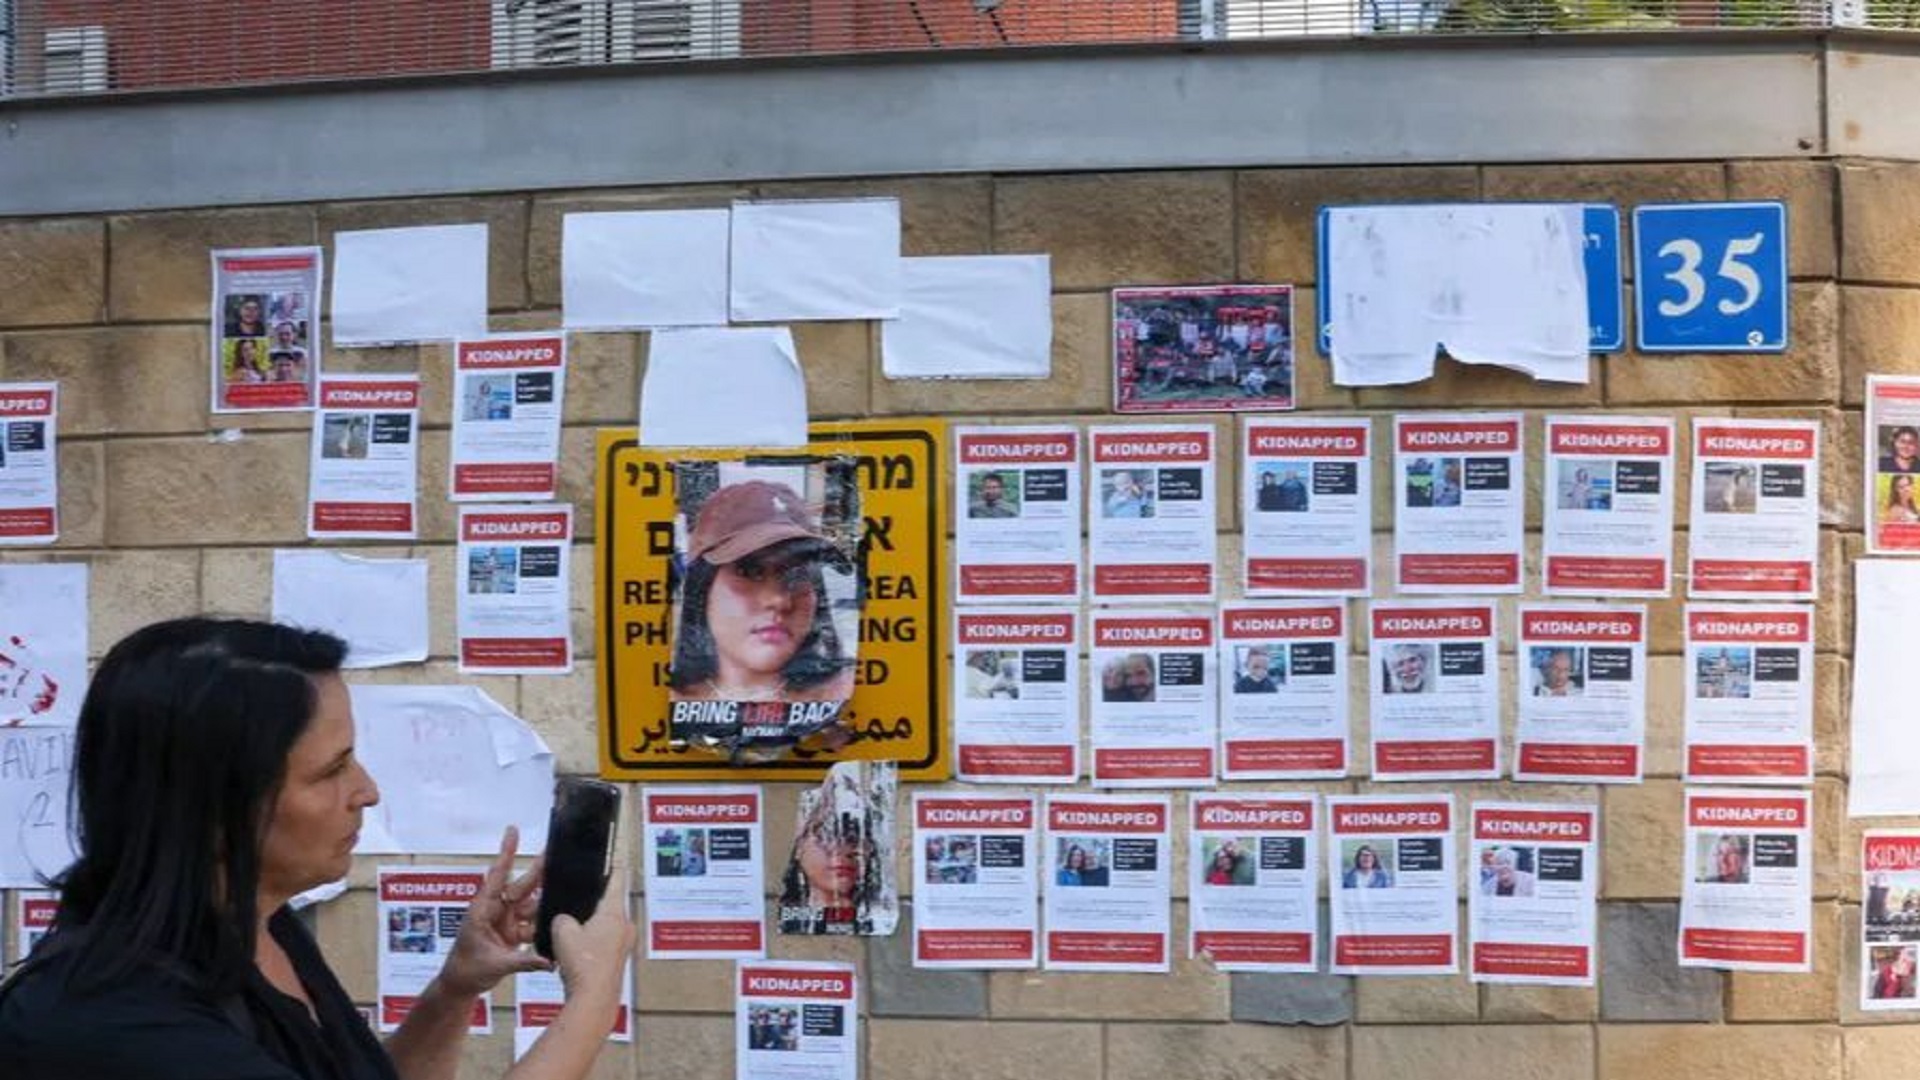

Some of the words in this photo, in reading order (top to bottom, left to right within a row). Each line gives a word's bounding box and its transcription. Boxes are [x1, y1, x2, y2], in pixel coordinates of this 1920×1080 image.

[1658, 232, 1764, 317] 35
[467, 349, 554, 363] KIDNAPPED
[327, 390, 413, 403] KIDNAPPED
[1257, 436, 1358, 449] KIDNAPPED
[1407, 431, 1509, 445] KIDNAPPED
[1558, 433, 1661, 447] KIDNAPPED
[1706, 436, 1805, 451] KIDNAPPED
[968, 443, 1068, 457] KIDNAPPED
[1101, 442, 1201, 455] KIDNAPPED
[471, 522, 562, 534] KIDNAPPED
[966, 623, 1066, 637] KIDNAPPED
[1233, 617, 1334, 631] KIDNAPPED
[1382, 616, 1482, 631] KIDNAPPED
[1530, 621, 1632, 636] KIDNAPPED
[1697, 621, 1799, 636] KIDNAPPED
[1102, 627, 1202, 640] KIDNAPPED
[672, 701, 738, 724] BRING
[655, 804, 751, 817] KIDNAPPED
[925, 808, 1024, 823] KIDNAPPED
[1203, 808, 1304, 823] KIDNAPPED
[1697, 806, 1798, 821] KIDNAPPED
[1057, 811, 1157, 825] KIDNAPPED
[1341, 812, 1441, 826] KIDNAPPED
[1482, 820, 1583, 836] KIDNAPPED
[388, 883, 477, 896] KIDNAPPED
[749, 978, 844, 992] KIDNAPPED
